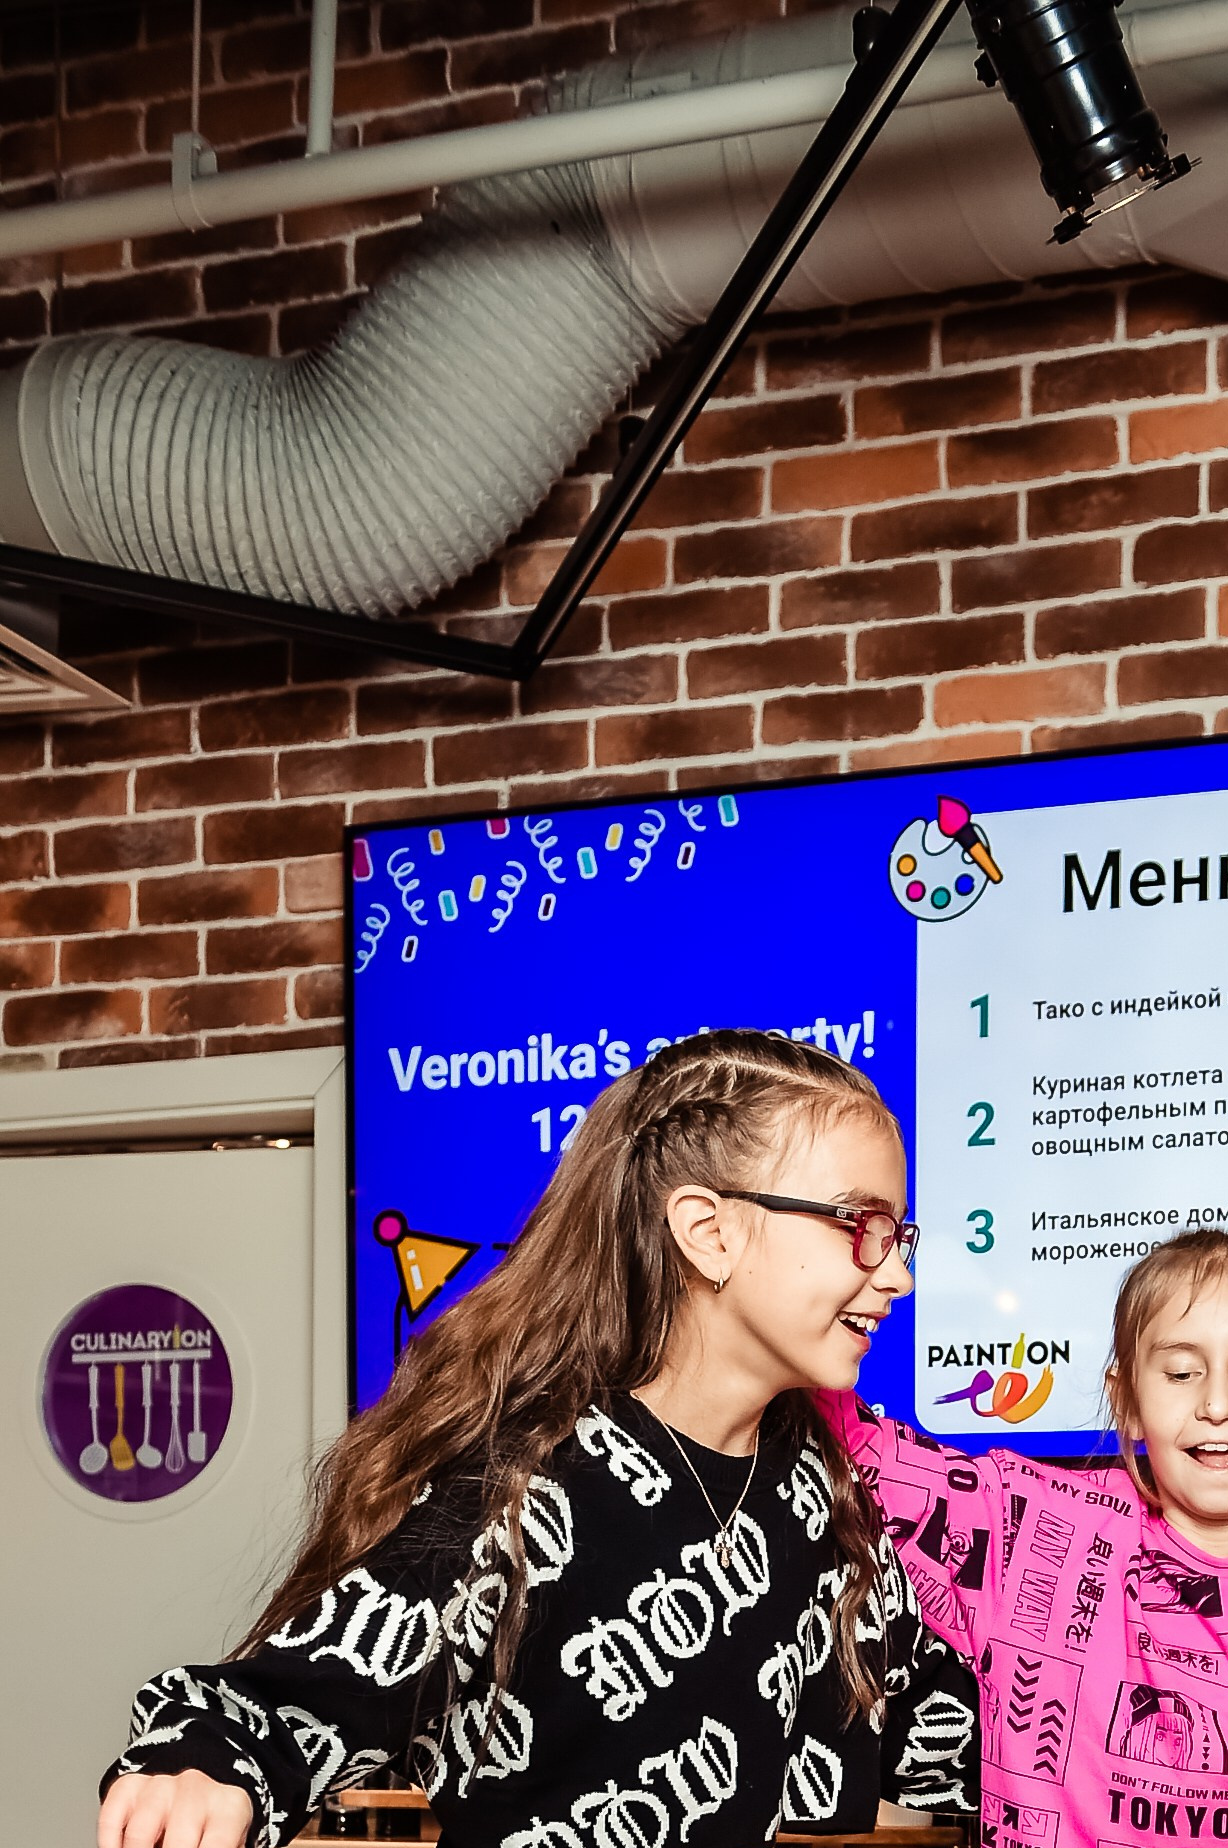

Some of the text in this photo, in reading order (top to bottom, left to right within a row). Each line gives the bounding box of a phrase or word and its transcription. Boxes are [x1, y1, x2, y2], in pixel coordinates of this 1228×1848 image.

[970, 993, 989, 1037] 1
[1033, 1000, 1085, 1021] Тако
[1091, 1003, 1103, 1017] с
[1110, 986, 1221, 1016] индейкой
[388, 1029, 631, 1091] Veronika's
[1033, 1074, 1126, 1100] Куриная
[1133, 1066, 1223, 1089] котлета
[967, 1101, 996, 1147] 2
[1031, 1096, 1206, 1131] картофельным
[1031, 1132, 1144, 1157] овощным
[966, 1209, 994, 1254] 3
[1031, 1206, 1179, 1231] Итальянское
[1050, 1479, 1081, 1500] MY
[1084, 1491, 1134, 1519] SOUL
[1009, 1509, 1076, 1643] MY WAY
[1111, 1771, 1150, 1790] DON'T
[1151, 1781, 1209, 1800] FOLLOW
